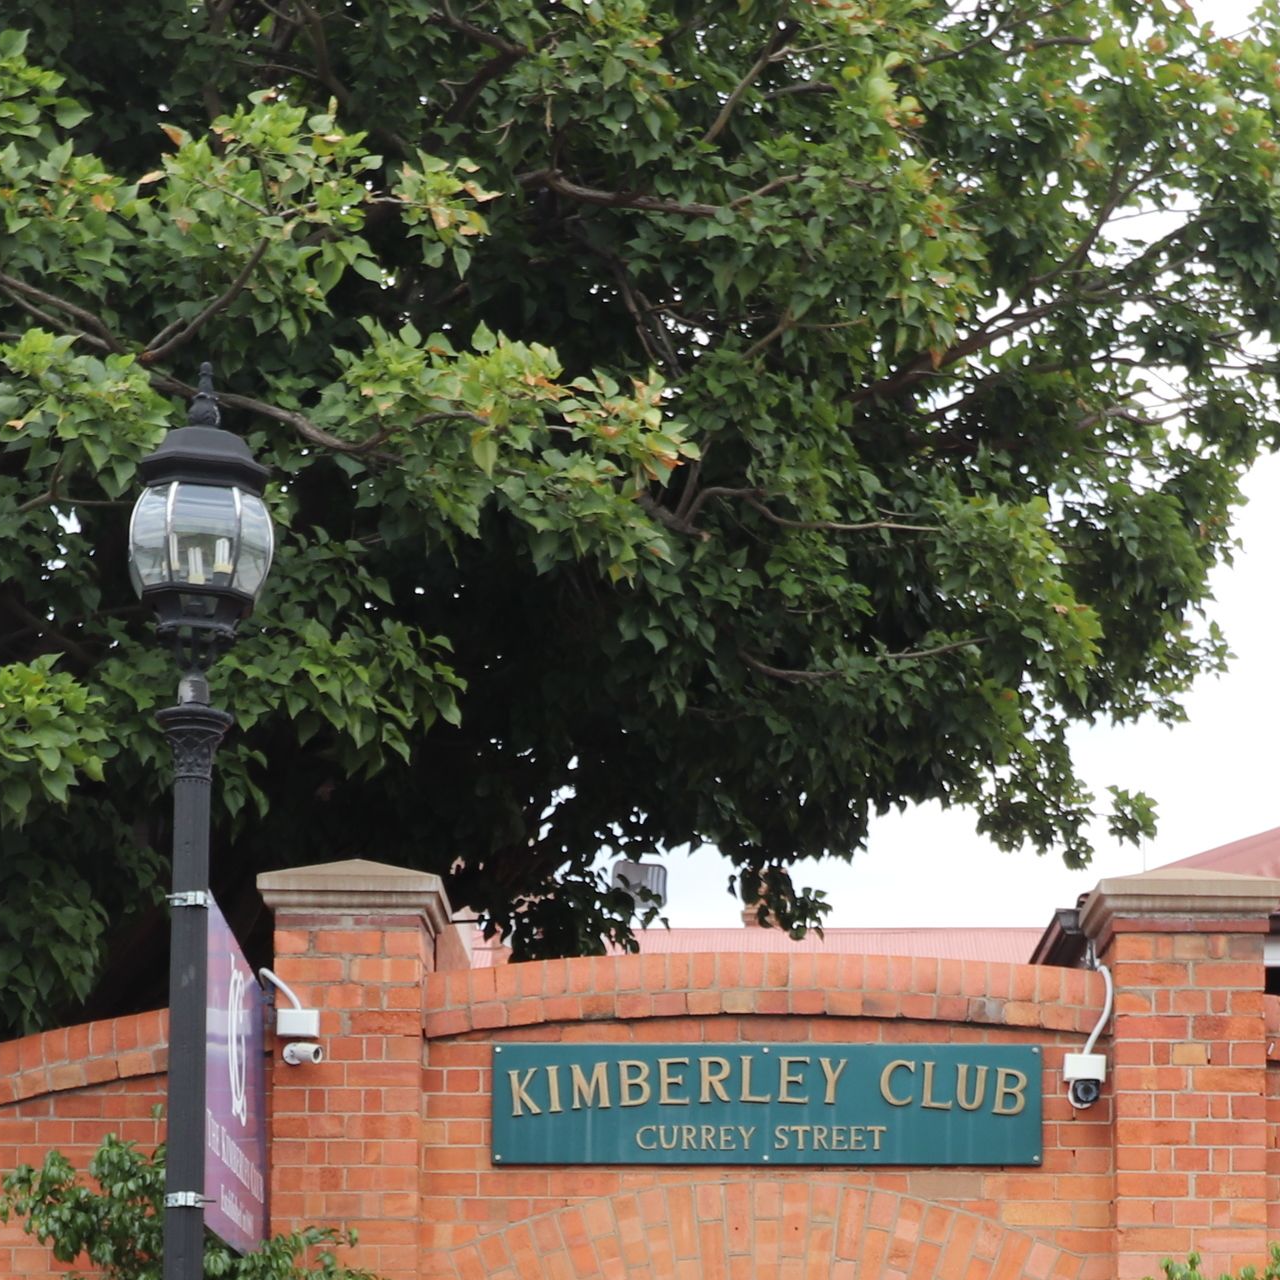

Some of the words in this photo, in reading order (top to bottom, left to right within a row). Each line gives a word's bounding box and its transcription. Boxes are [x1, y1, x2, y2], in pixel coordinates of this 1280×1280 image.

[507, 1055, 848, 1117] KIMBERLEY
[879, 1059, 1028, 1116] CLUB
[636, 1125, 756, 1150] CURREY
[774, 1125, 887, 1150] STREET
